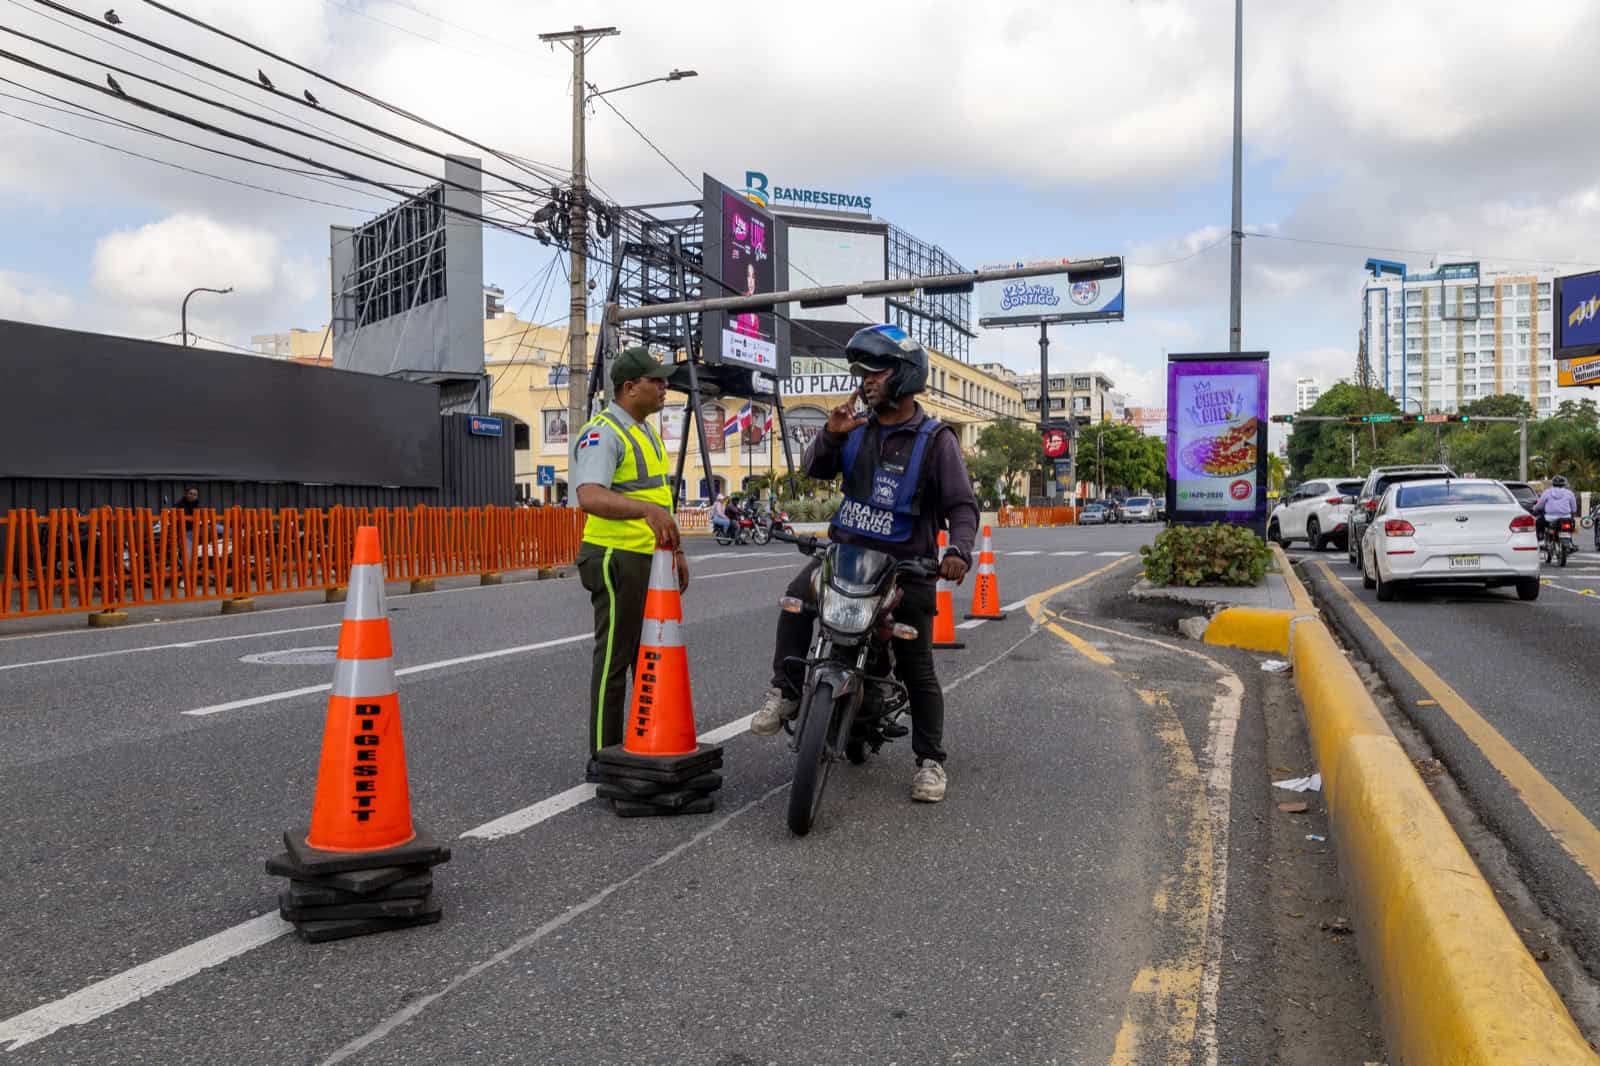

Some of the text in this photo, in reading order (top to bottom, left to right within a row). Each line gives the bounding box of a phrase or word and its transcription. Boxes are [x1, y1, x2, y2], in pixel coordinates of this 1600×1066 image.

[773, 186, 872, 209] BANRESERVAS
[1026, 284, 1055, 296] AÑOS
[1001, 294, 1060, 310] CONTIGO!
[810, 375, 860, 393] PLAZA
[849, 512, 892, 529] COLINA
[634, 651, 661, 737] DIGESETT
[351, 704, 381, 822] DIGESETT
